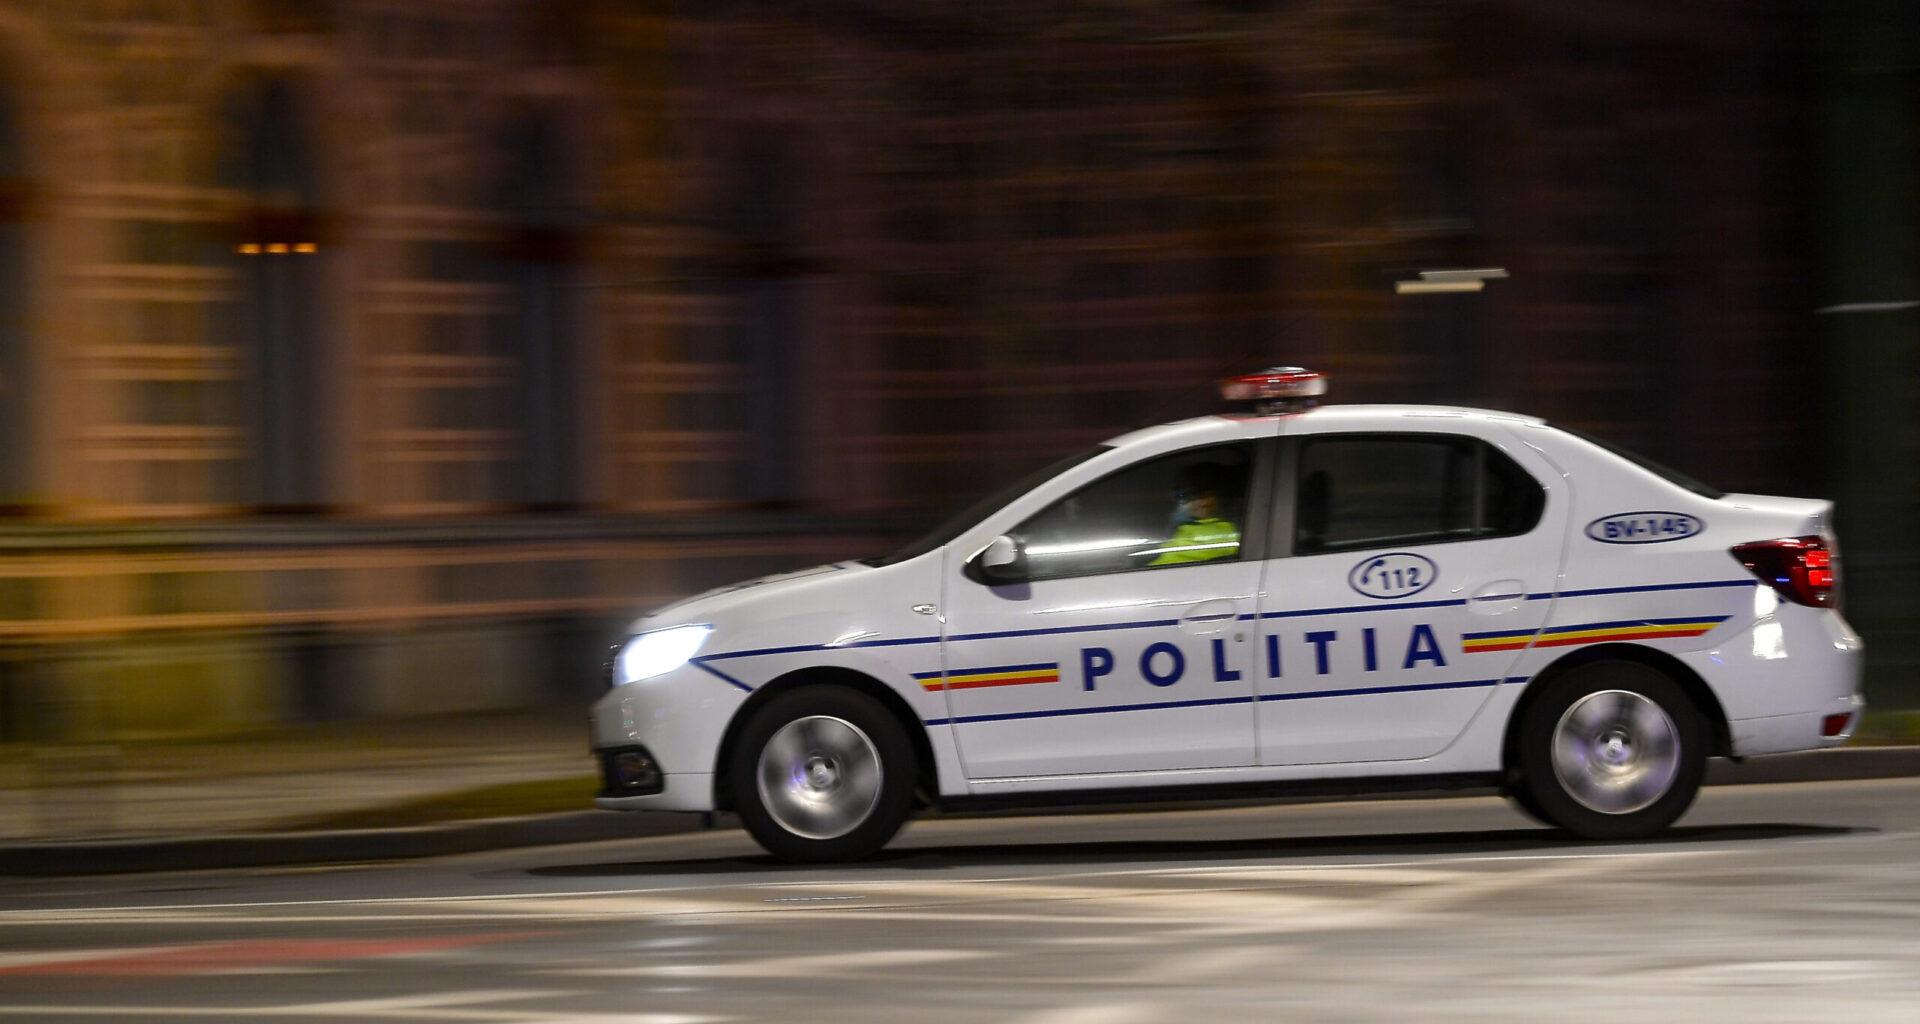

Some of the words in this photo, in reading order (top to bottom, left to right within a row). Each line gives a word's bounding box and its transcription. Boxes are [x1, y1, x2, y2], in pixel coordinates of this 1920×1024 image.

[1603, 517, 1691, 539] BV-145
[1378, 566, 1422, 590] 112
[1080, 623, 1448, 692] POLITIA
